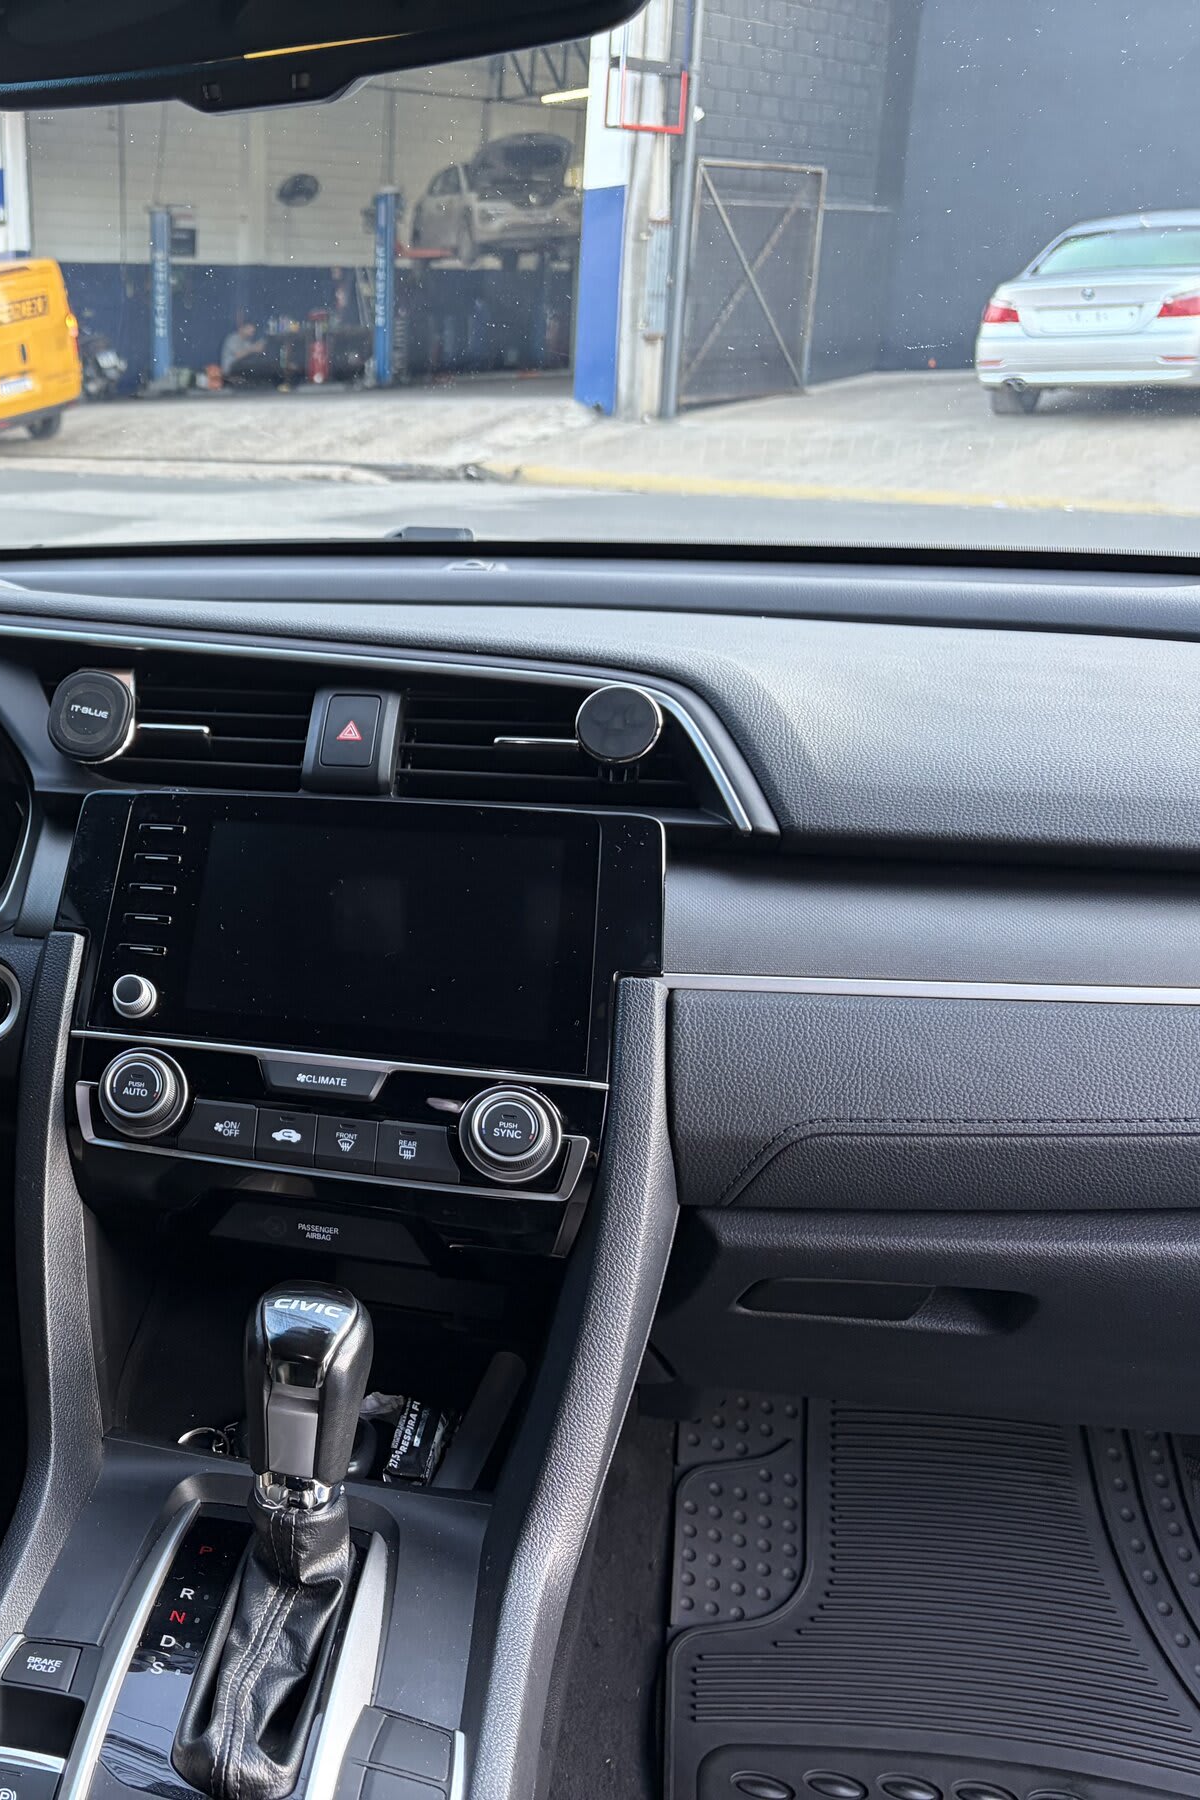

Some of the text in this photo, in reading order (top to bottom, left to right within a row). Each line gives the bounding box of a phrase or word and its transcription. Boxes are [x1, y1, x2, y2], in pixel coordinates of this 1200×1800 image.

[305, 1074, 348, 1087] CLIMATE
[122, 1087, 148, 1097] AUTO
[223, 1120, 241, 1129] ON/
[499, 1121, 518, 1129] PUSH
[223, 1129, 240, 1137] OFF
[335, 1132, 358, 1140] FRONT
[493, 1128, 522, 1139] SYNC
[297, 1223, 340, 1235] PASSENGER
[305, 1232, 332, 1241] AIRBAG
[273, 1298, 343, 1319] CIVIC
[399, 1412, 418, 1453] RESPIRA
[200, 1546, 213, 1555] P
[180, 1587, 195, 1600] R
[169, 1610, 186, 1624] N
[160, 1634, 176, 1648] D
[27, 1655, 63, 1668] BRAKE
[27, 1663, 56, 1673] HOLD
[150, 1661, 164, 1675] S
